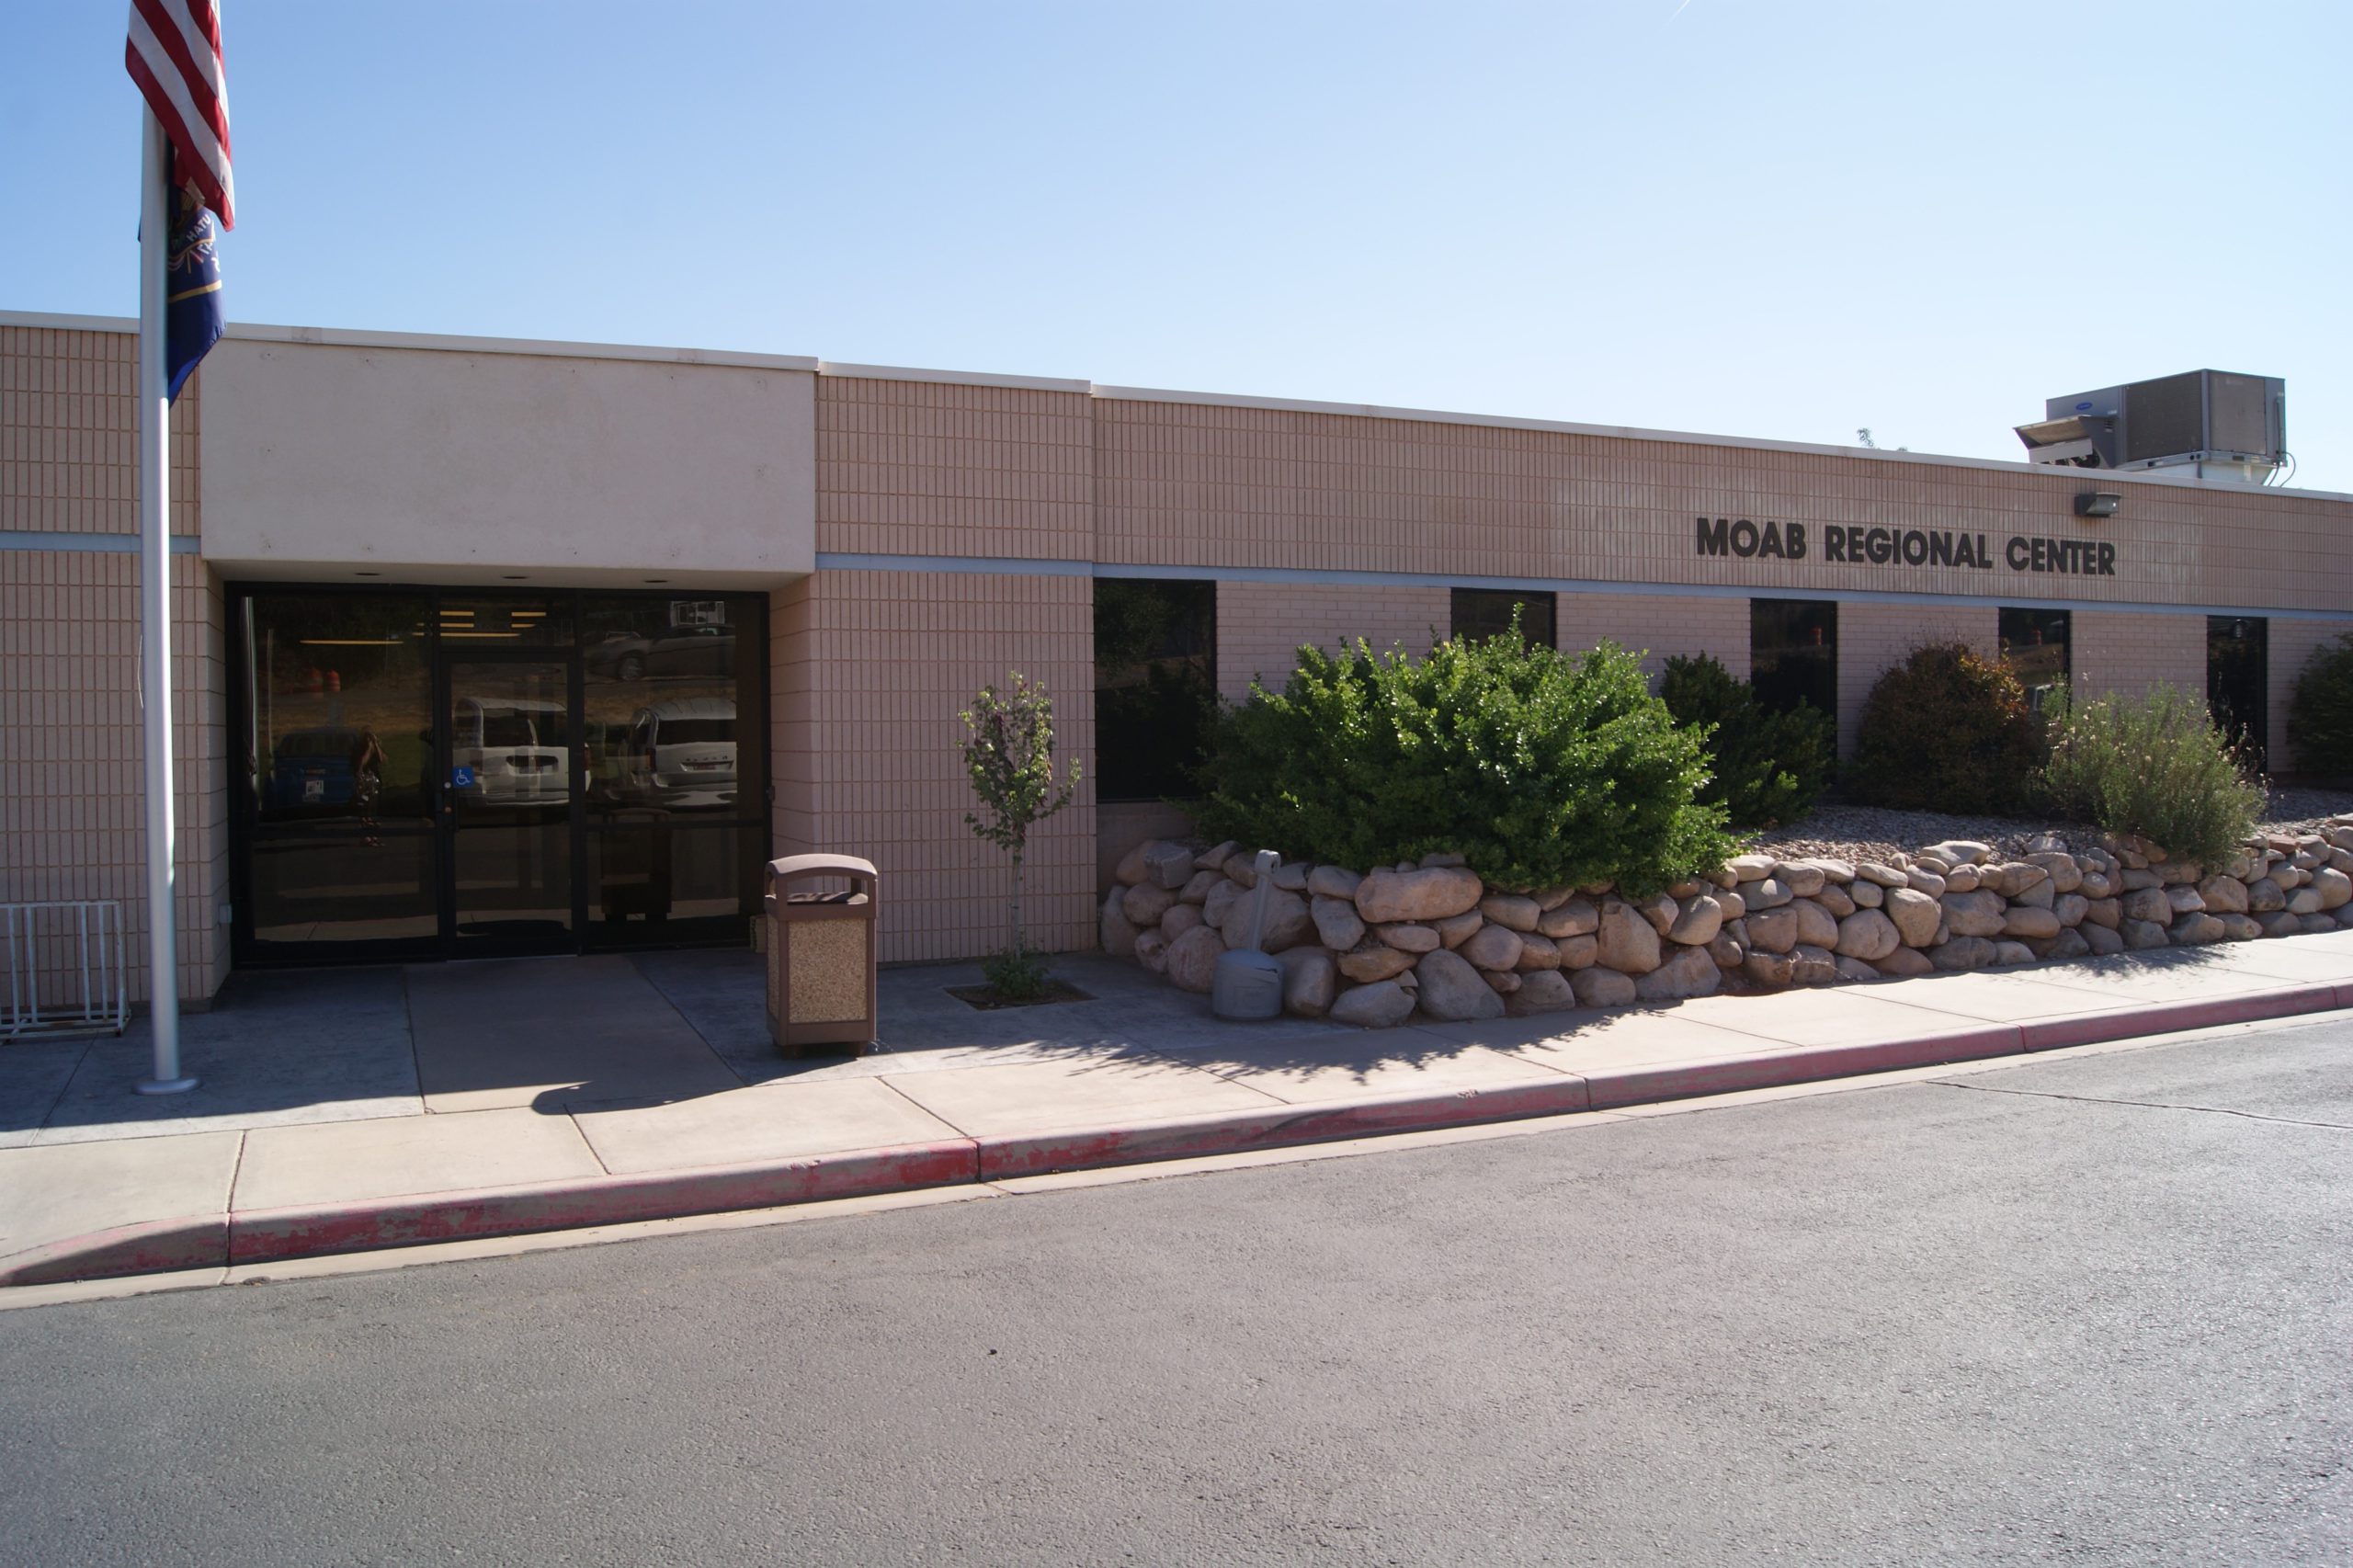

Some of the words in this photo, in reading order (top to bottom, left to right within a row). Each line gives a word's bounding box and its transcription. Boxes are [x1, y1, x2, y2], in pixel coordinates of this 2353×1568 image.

[1697, 517, 1806, 560] MOAB
[1825, 525, 1993, 569] REGIONAL
[2006, 536, 2115, 575] CENTER
